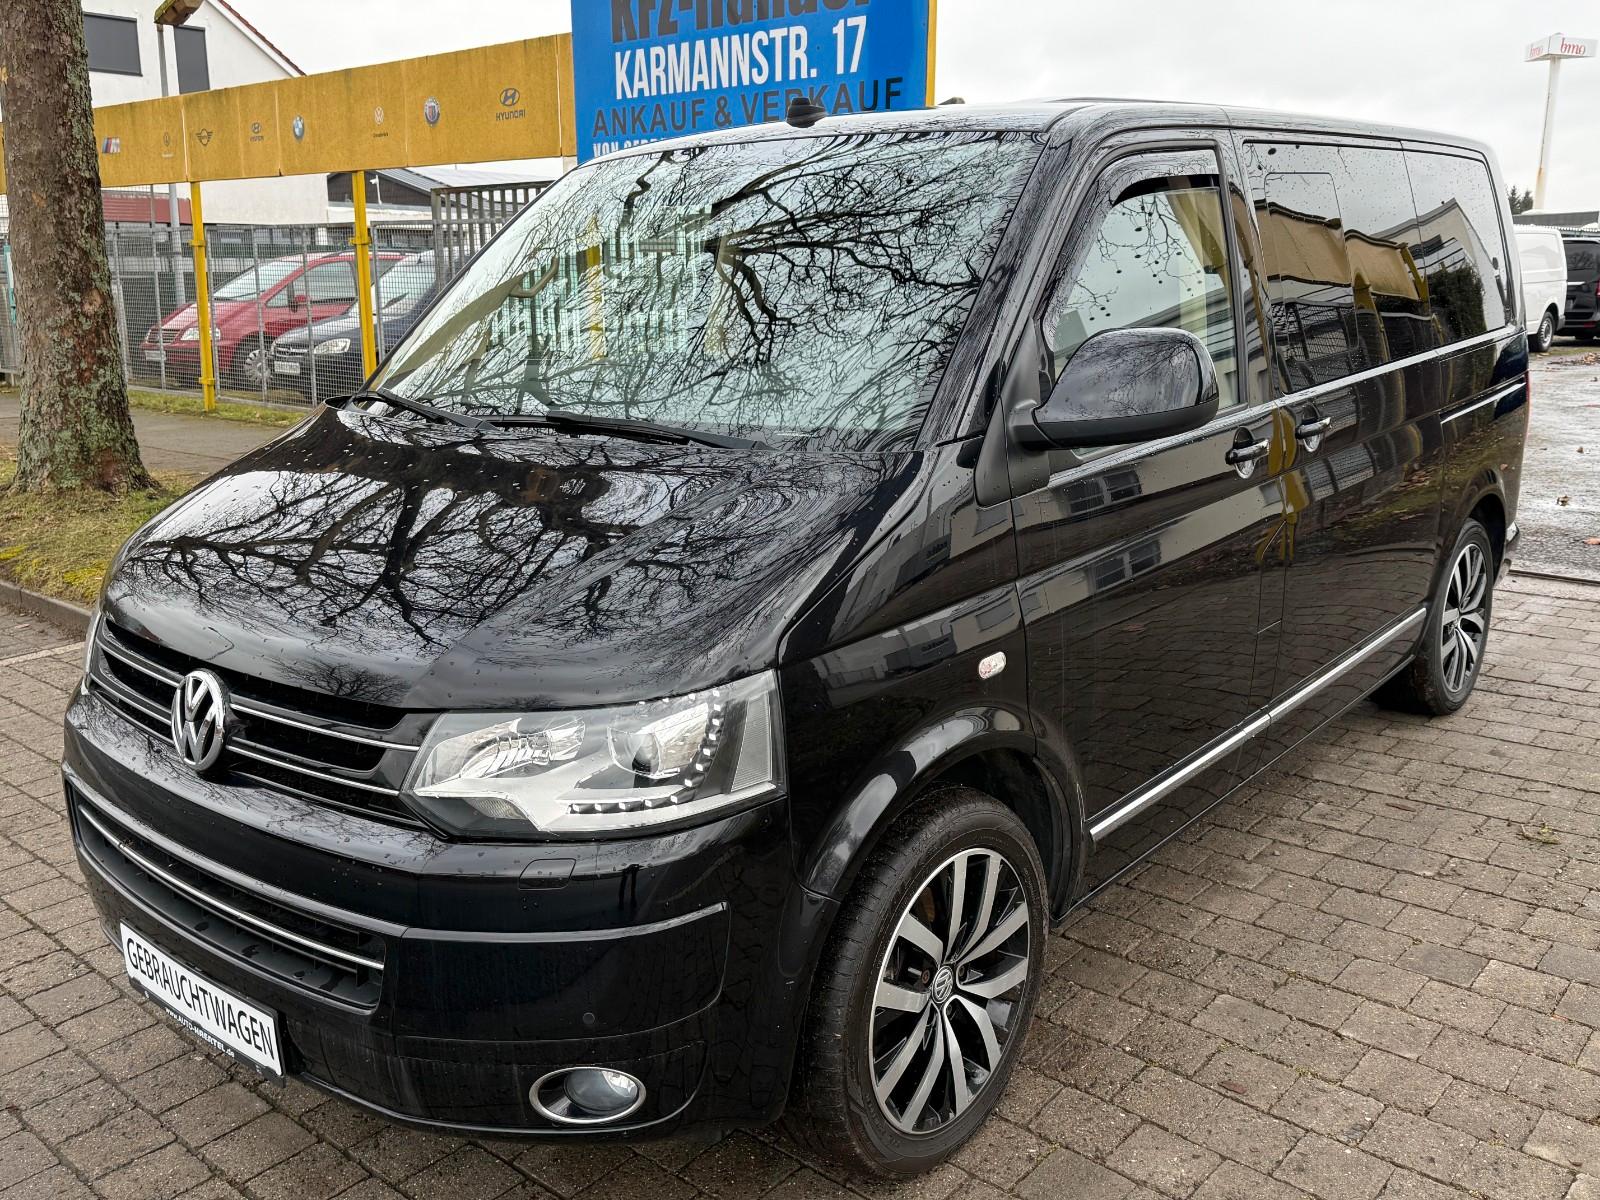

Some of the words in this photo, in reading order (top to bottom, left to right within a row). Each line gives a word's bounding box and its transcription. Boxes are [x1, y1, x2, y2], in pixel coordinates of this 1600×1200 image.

[615, 25, 817, 100] KARMANNSTR.
[832, 15, 867, 75] 17
[496, 109, 526, 121] HYUNDAI
[592, 98, 705, 138] ANKAUF
[714, 95, 733, 127] &
[127, 937, 275, 1061] GEBRAUCHTWAGEN
